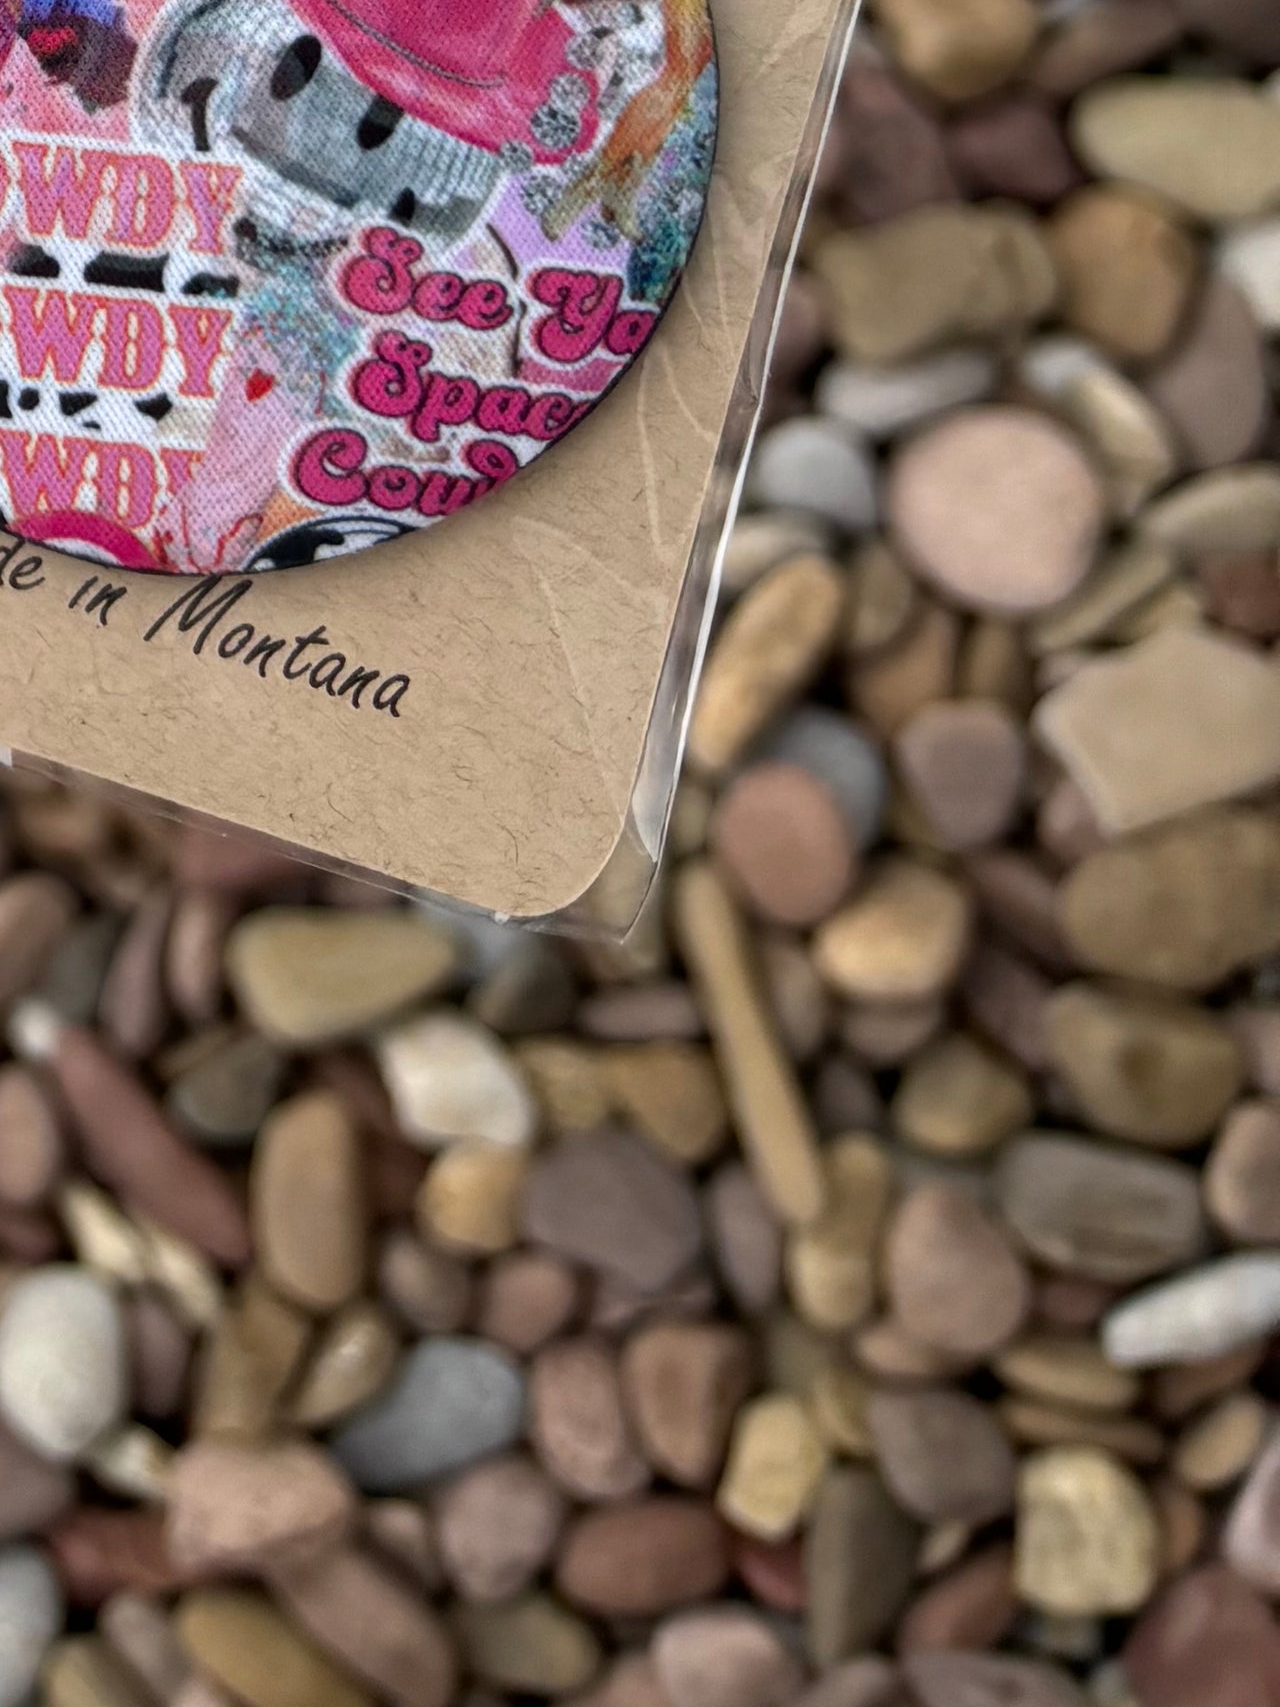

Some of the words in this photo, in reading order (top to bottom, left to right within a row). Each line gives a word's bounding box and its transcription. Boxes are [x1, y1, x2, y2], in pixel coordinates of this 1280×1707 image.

[342, 225, 515, 331] See
[68, 574, 130, 627] in
[142, 573, 412, 718] Montana
